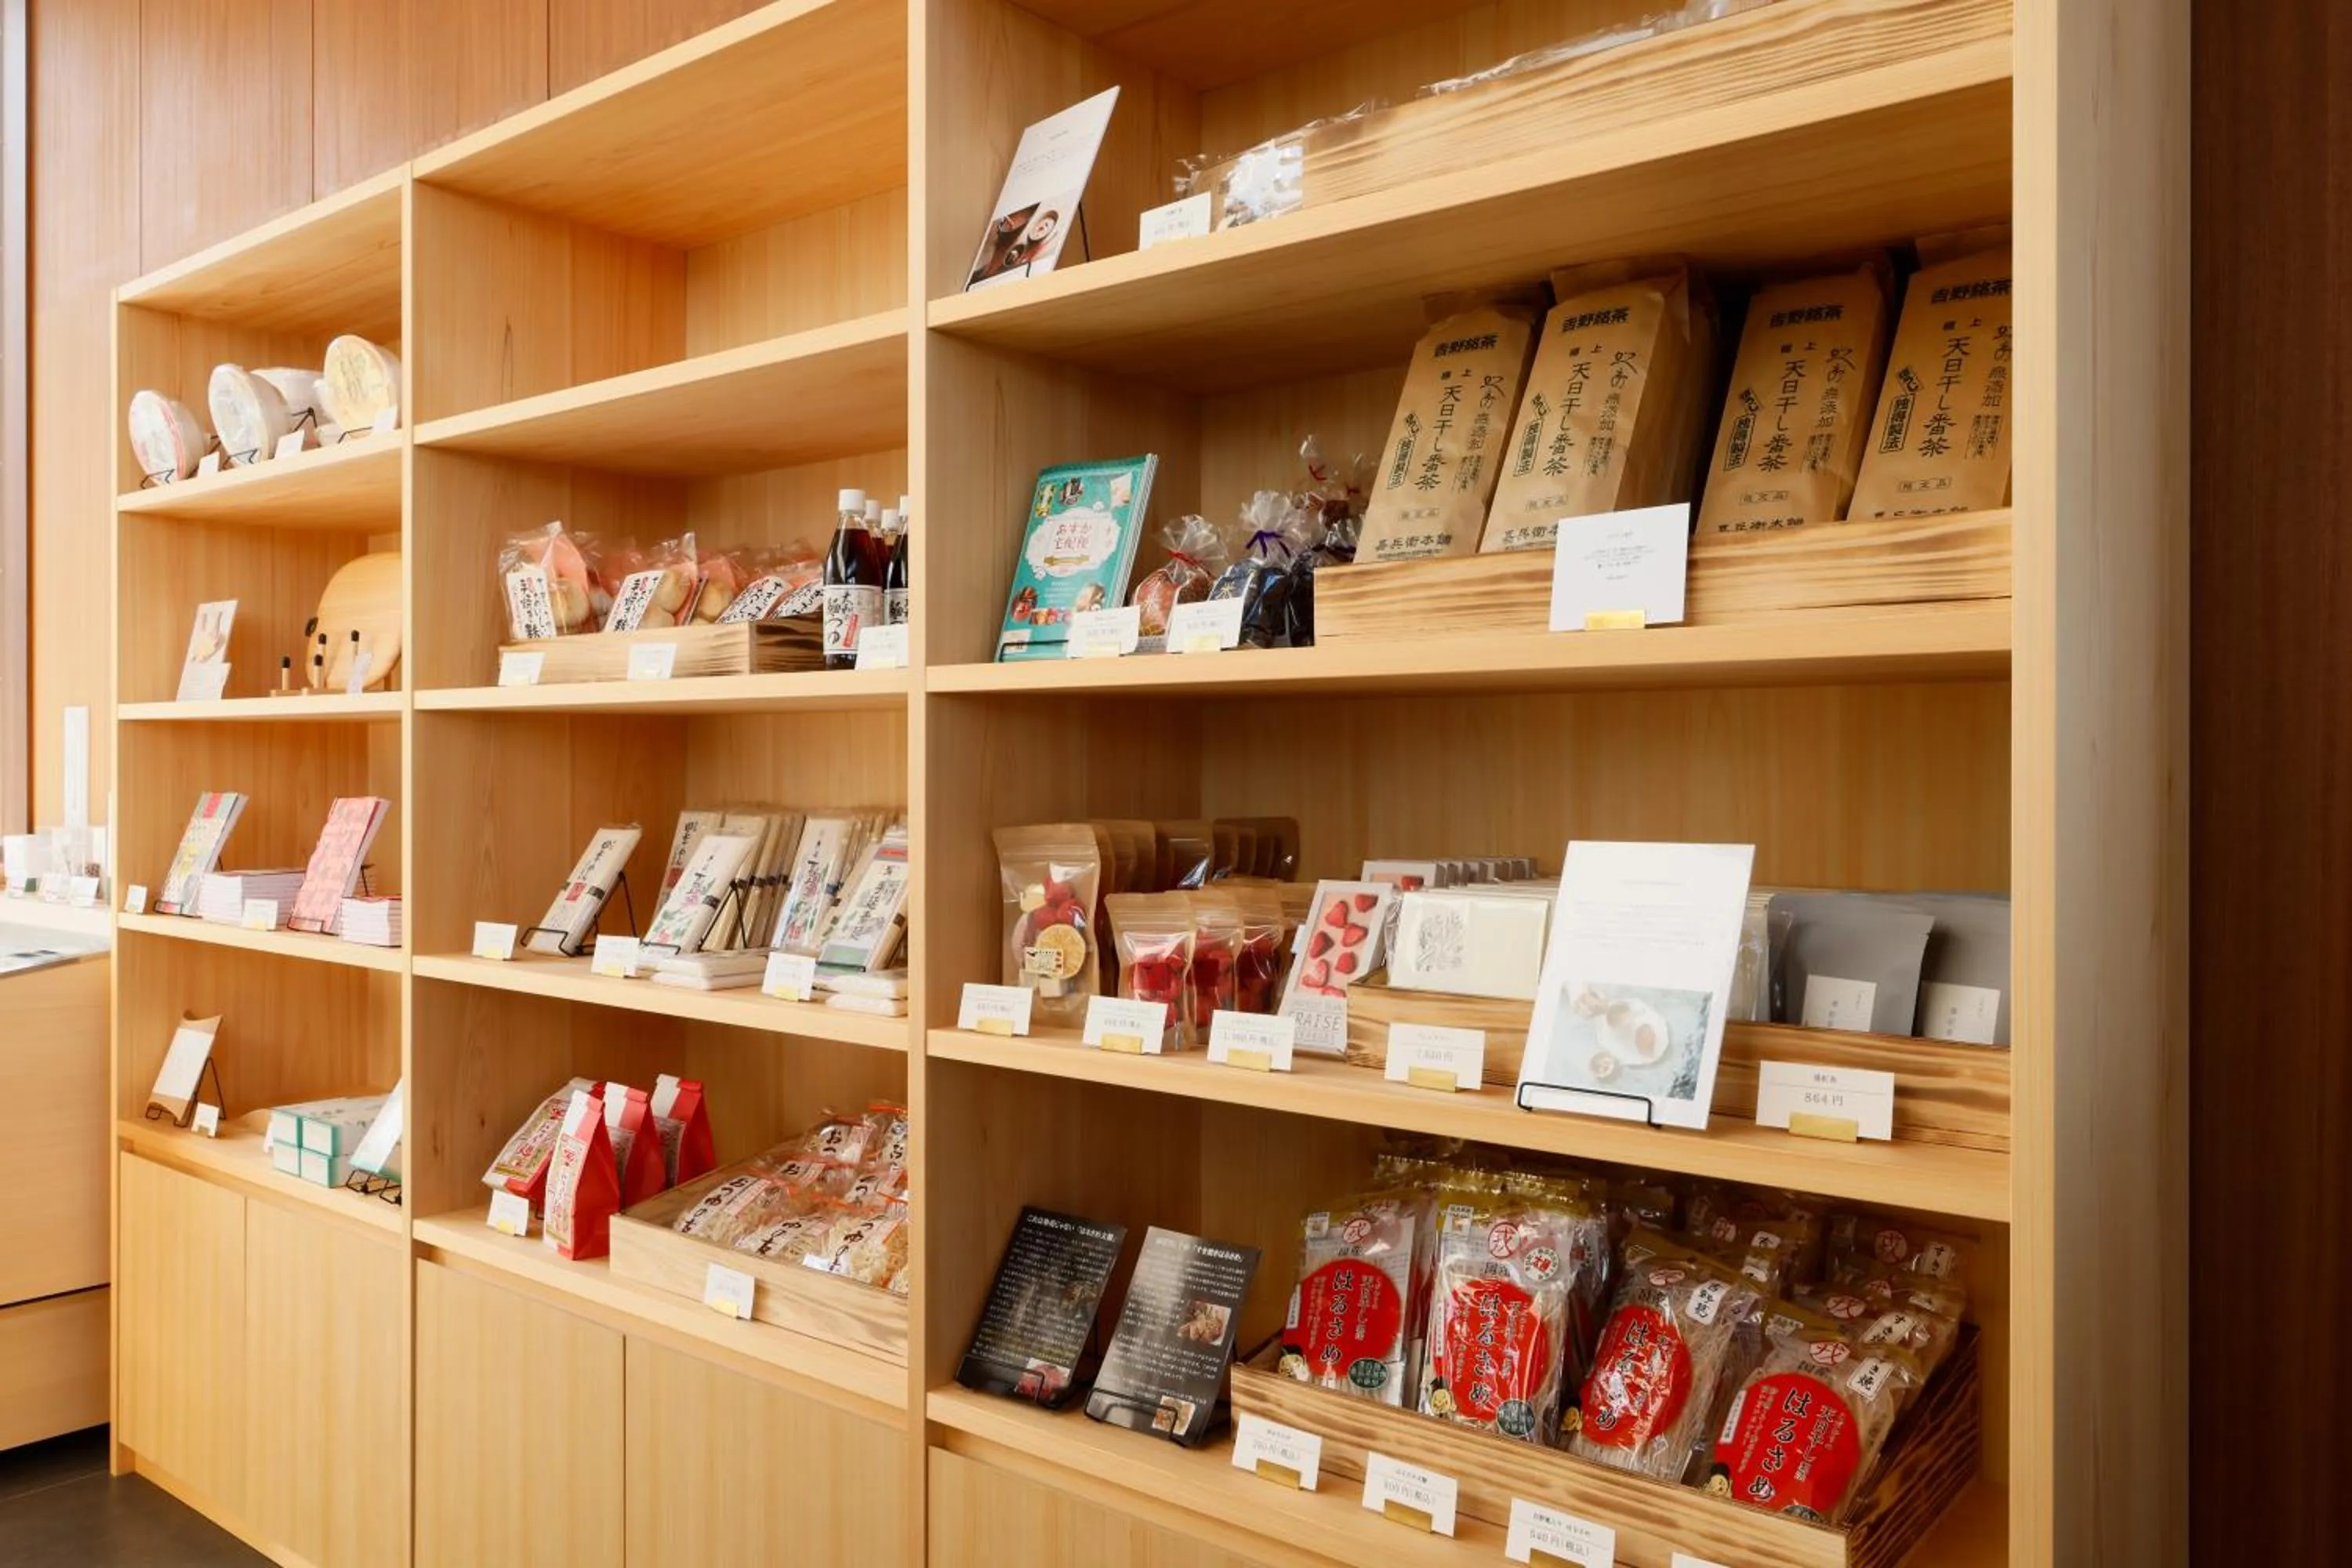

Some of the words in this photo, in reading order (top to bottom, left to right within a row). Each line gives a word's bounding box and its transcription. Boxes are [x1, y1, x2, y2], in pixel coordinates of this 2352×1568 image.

[1414, 385, 1463, 490] 天日干し番茶
[1543, 361, 1592, 476] 天日干し番茶
[1756, 360, 1806, 472] 天日干し番茶
[1918, 336, 1972, 458] 天日干し番茶
[1320, 1269, 1353, 1365] はるさめ
[1469, 1293, 1501, 1406] はるさめ
[1596, 1318, 1650, 1430] はるめ
[1749, 1388, 1813, 1501] はるさめ
